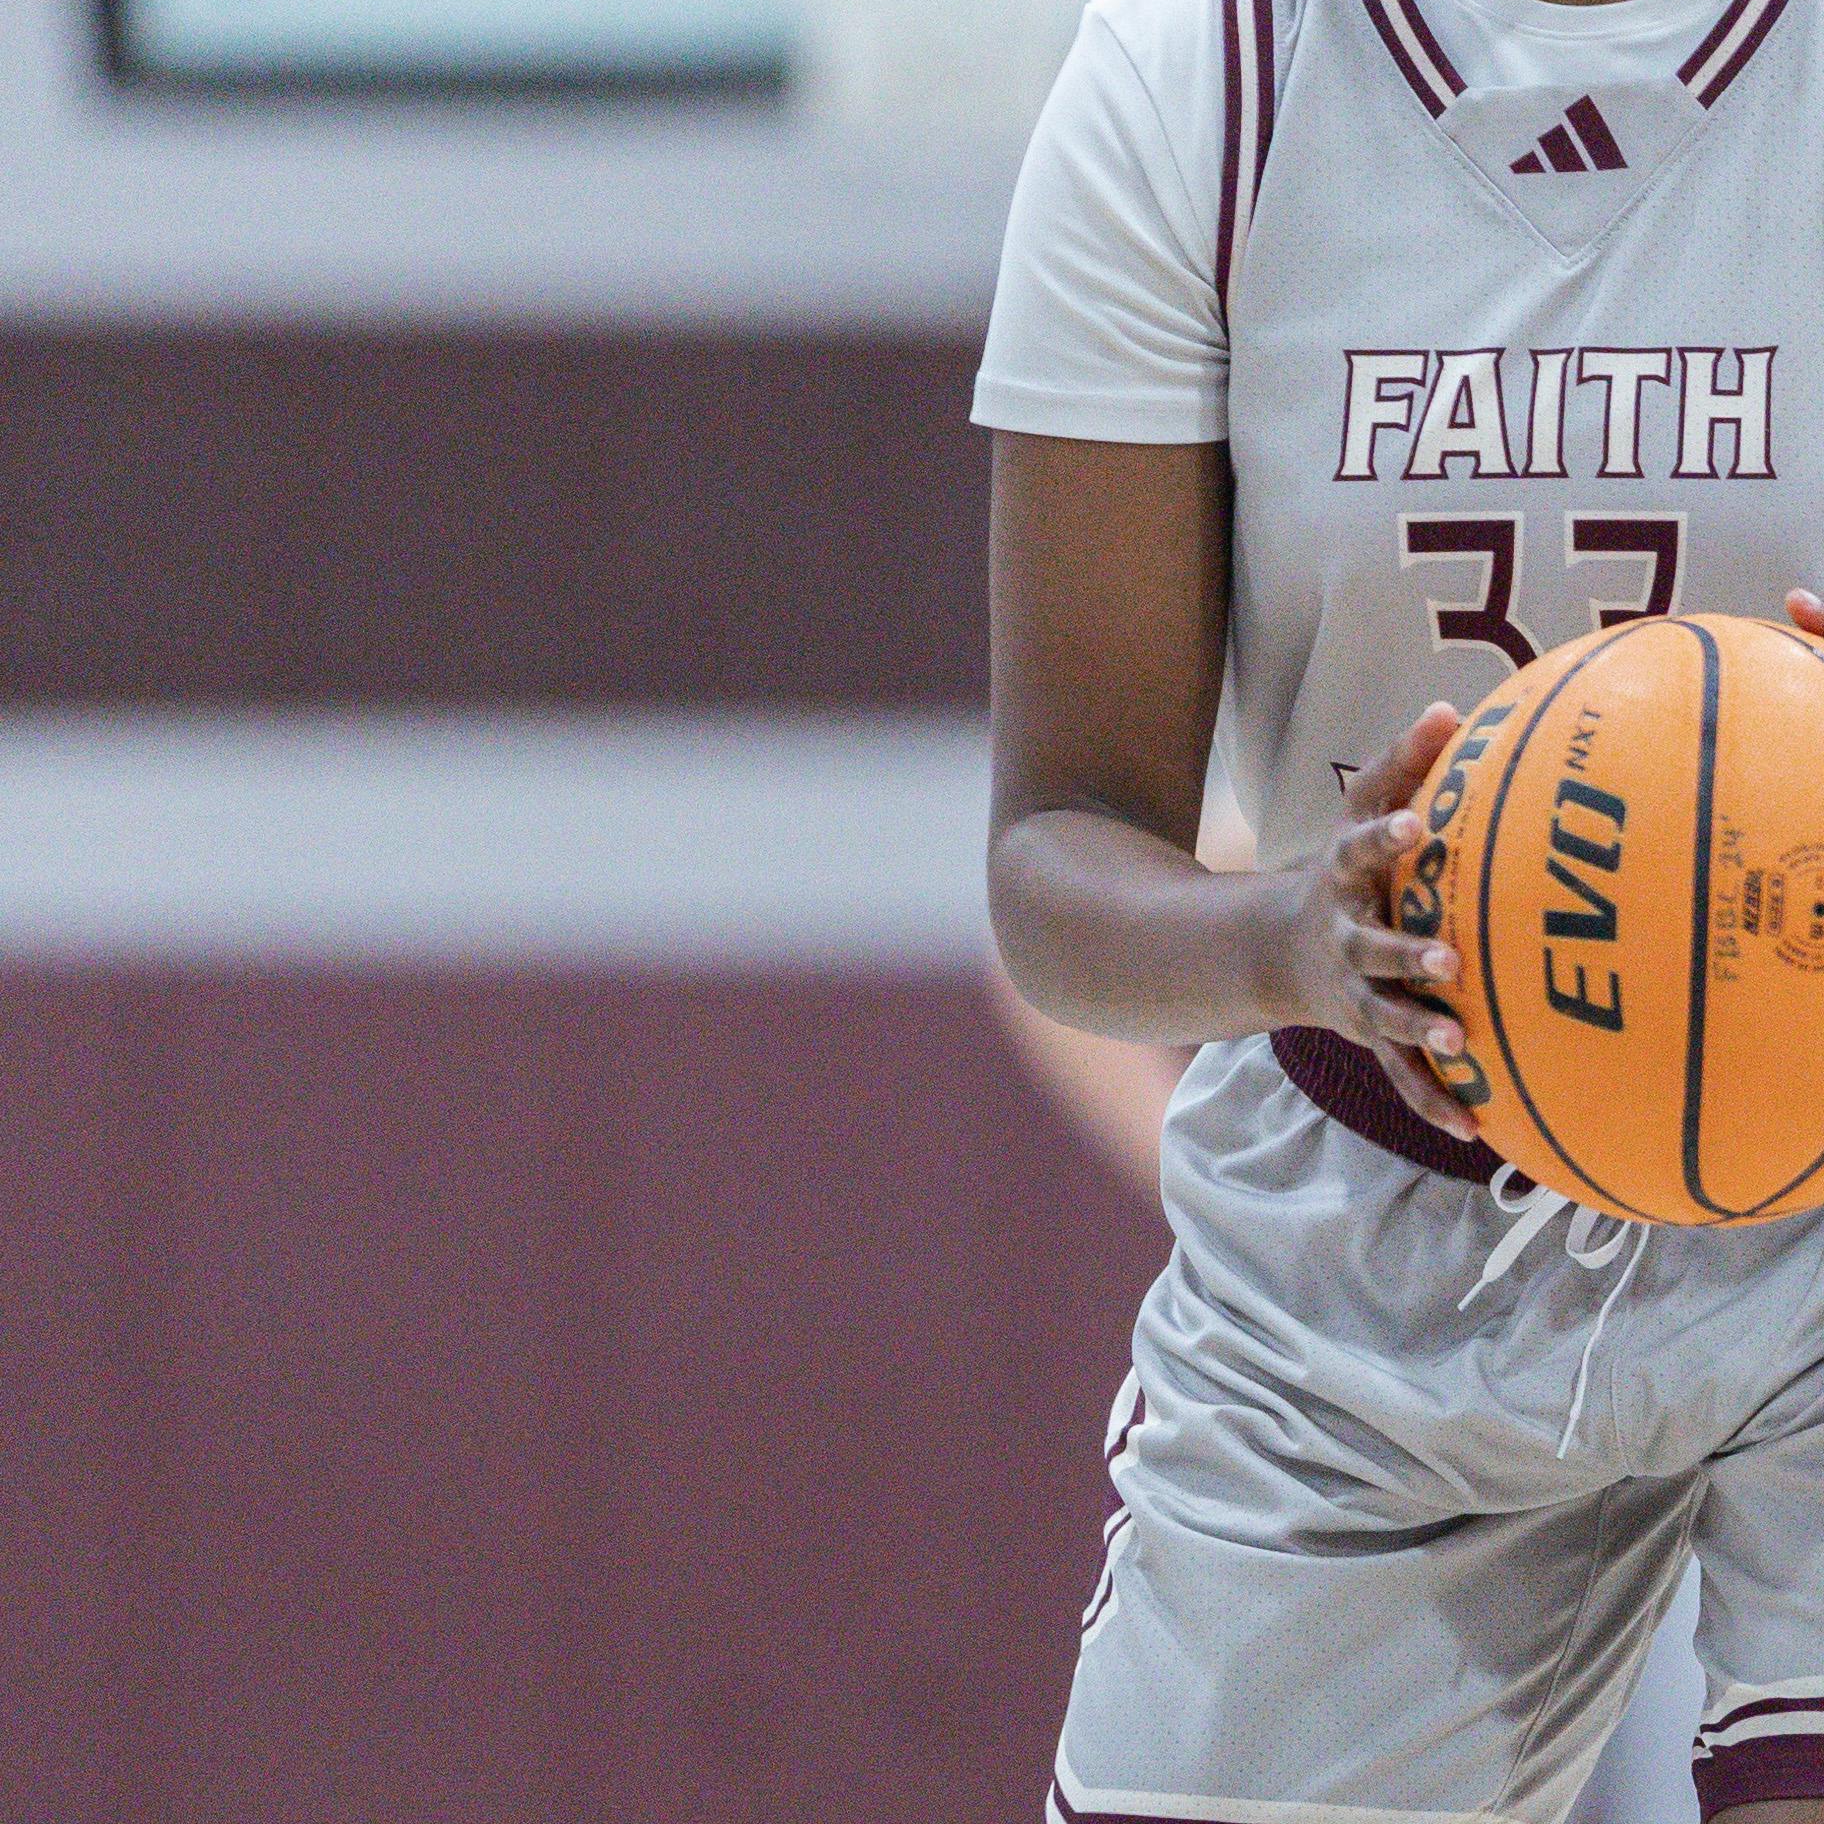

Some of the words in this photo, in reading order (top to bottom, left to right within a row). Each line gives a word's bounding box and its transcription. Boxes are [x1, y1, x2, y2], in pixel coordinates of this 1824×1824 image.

[1332, 345, 1780, 482] FAITH
[1565, 705, 1602, 773] NXT
[1543, 779, 1626, 1032] EVO
